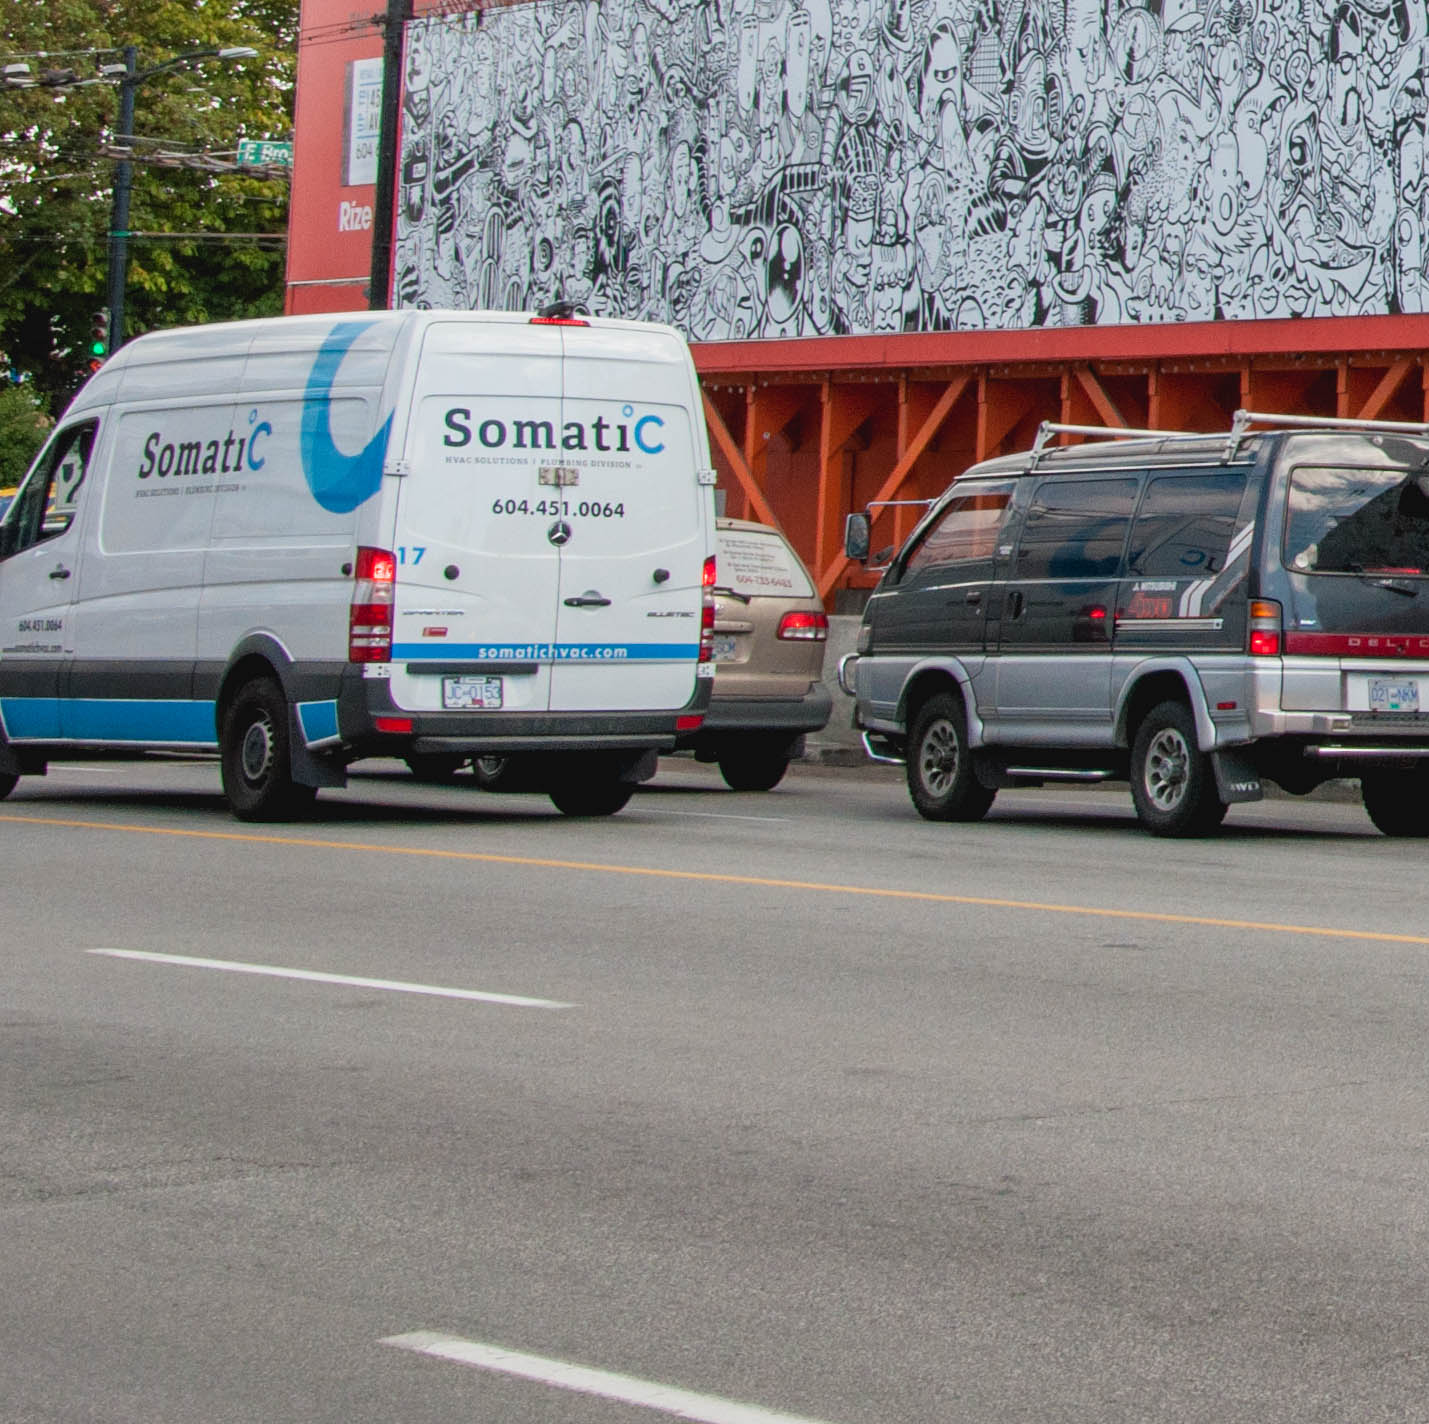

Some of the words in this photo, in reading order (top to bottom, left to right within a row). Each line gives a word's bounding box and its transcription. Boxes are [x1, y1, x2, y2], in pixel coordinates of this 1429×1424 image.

[445, 455, 473, 465] HVAC
[474, 456, 529, 465] SOLUTIONS
[540, 457, 589, 468] PLUMBING
[590, 458, 632, 469] DIVISION
[492, 498, 626, 518] 604.451.0064
[397, 546, 427, 566] 17
[477, 644, 628, 659] somatichvac.com
